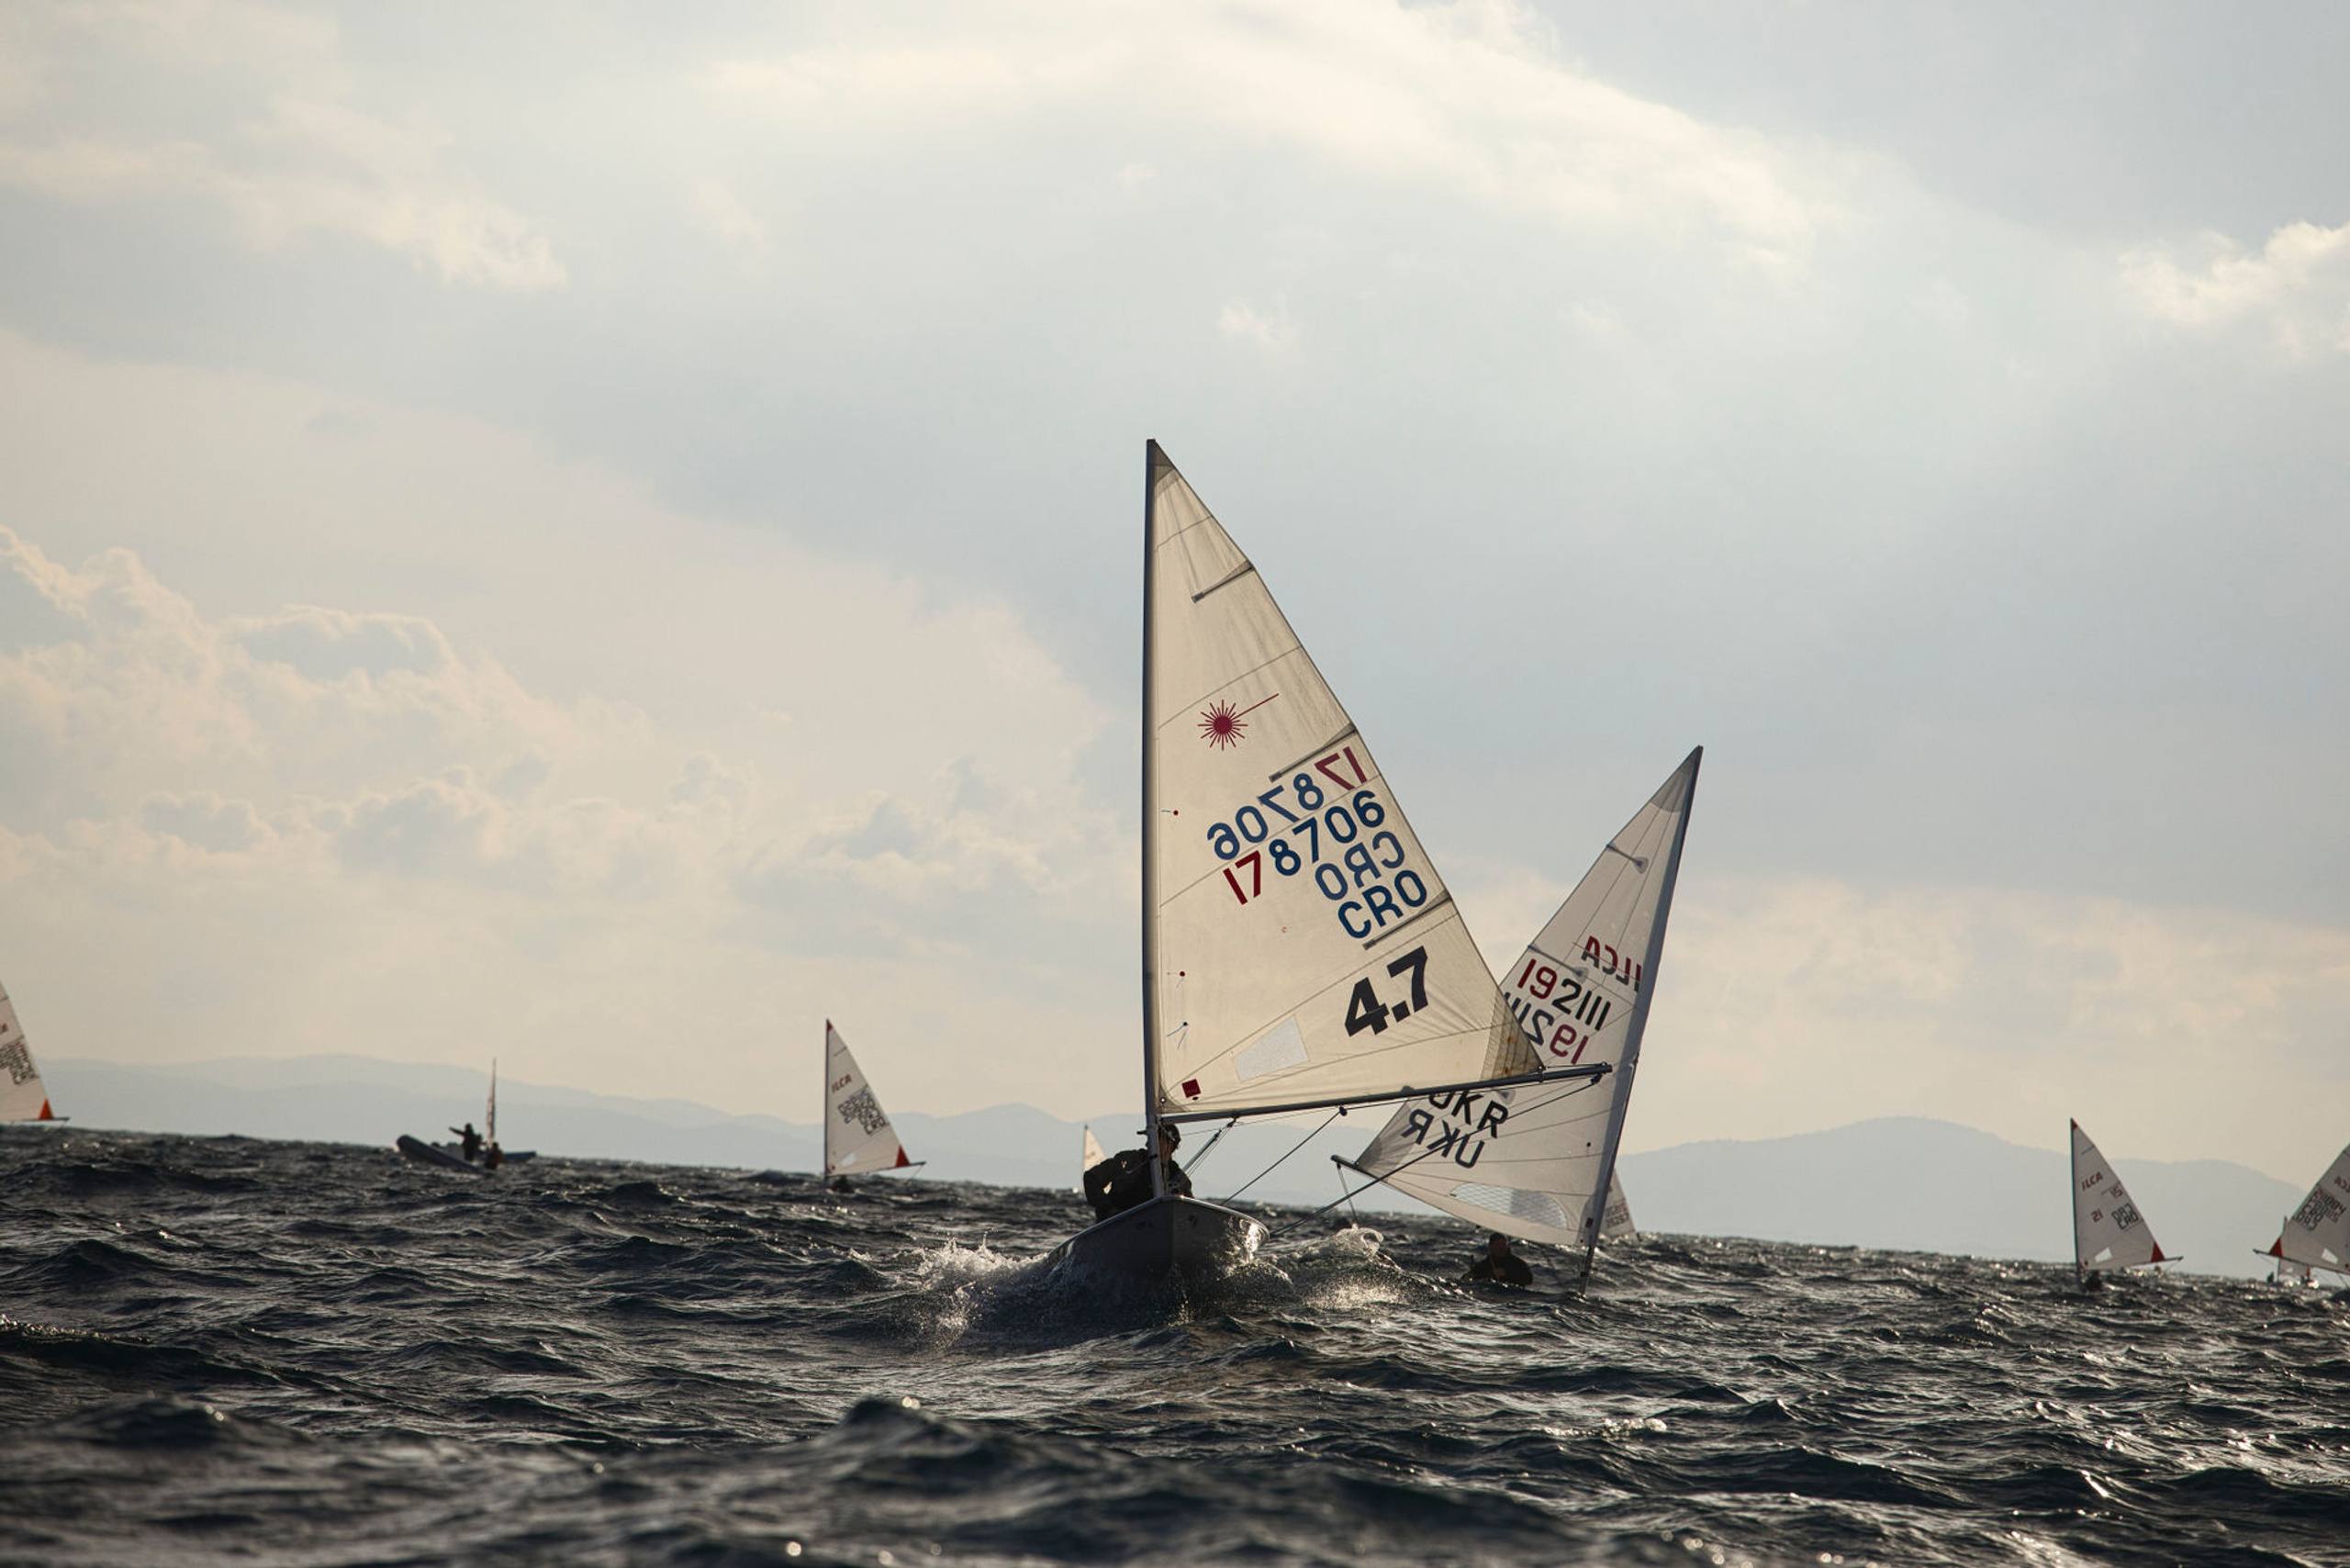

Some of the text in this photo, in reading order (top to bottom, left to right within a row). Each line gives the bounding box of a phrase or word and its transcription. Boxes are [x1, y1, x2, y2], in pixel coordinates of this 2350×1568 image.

[1223, 790, 1385, 905] 178706
[1337, 869, 1427, 938] CRO
[1344, 946, 1428, 1037] 4.7
[1517, 958, 1611, 1031] 192111
[2081, 1172, 2103, 1192] ILCA
